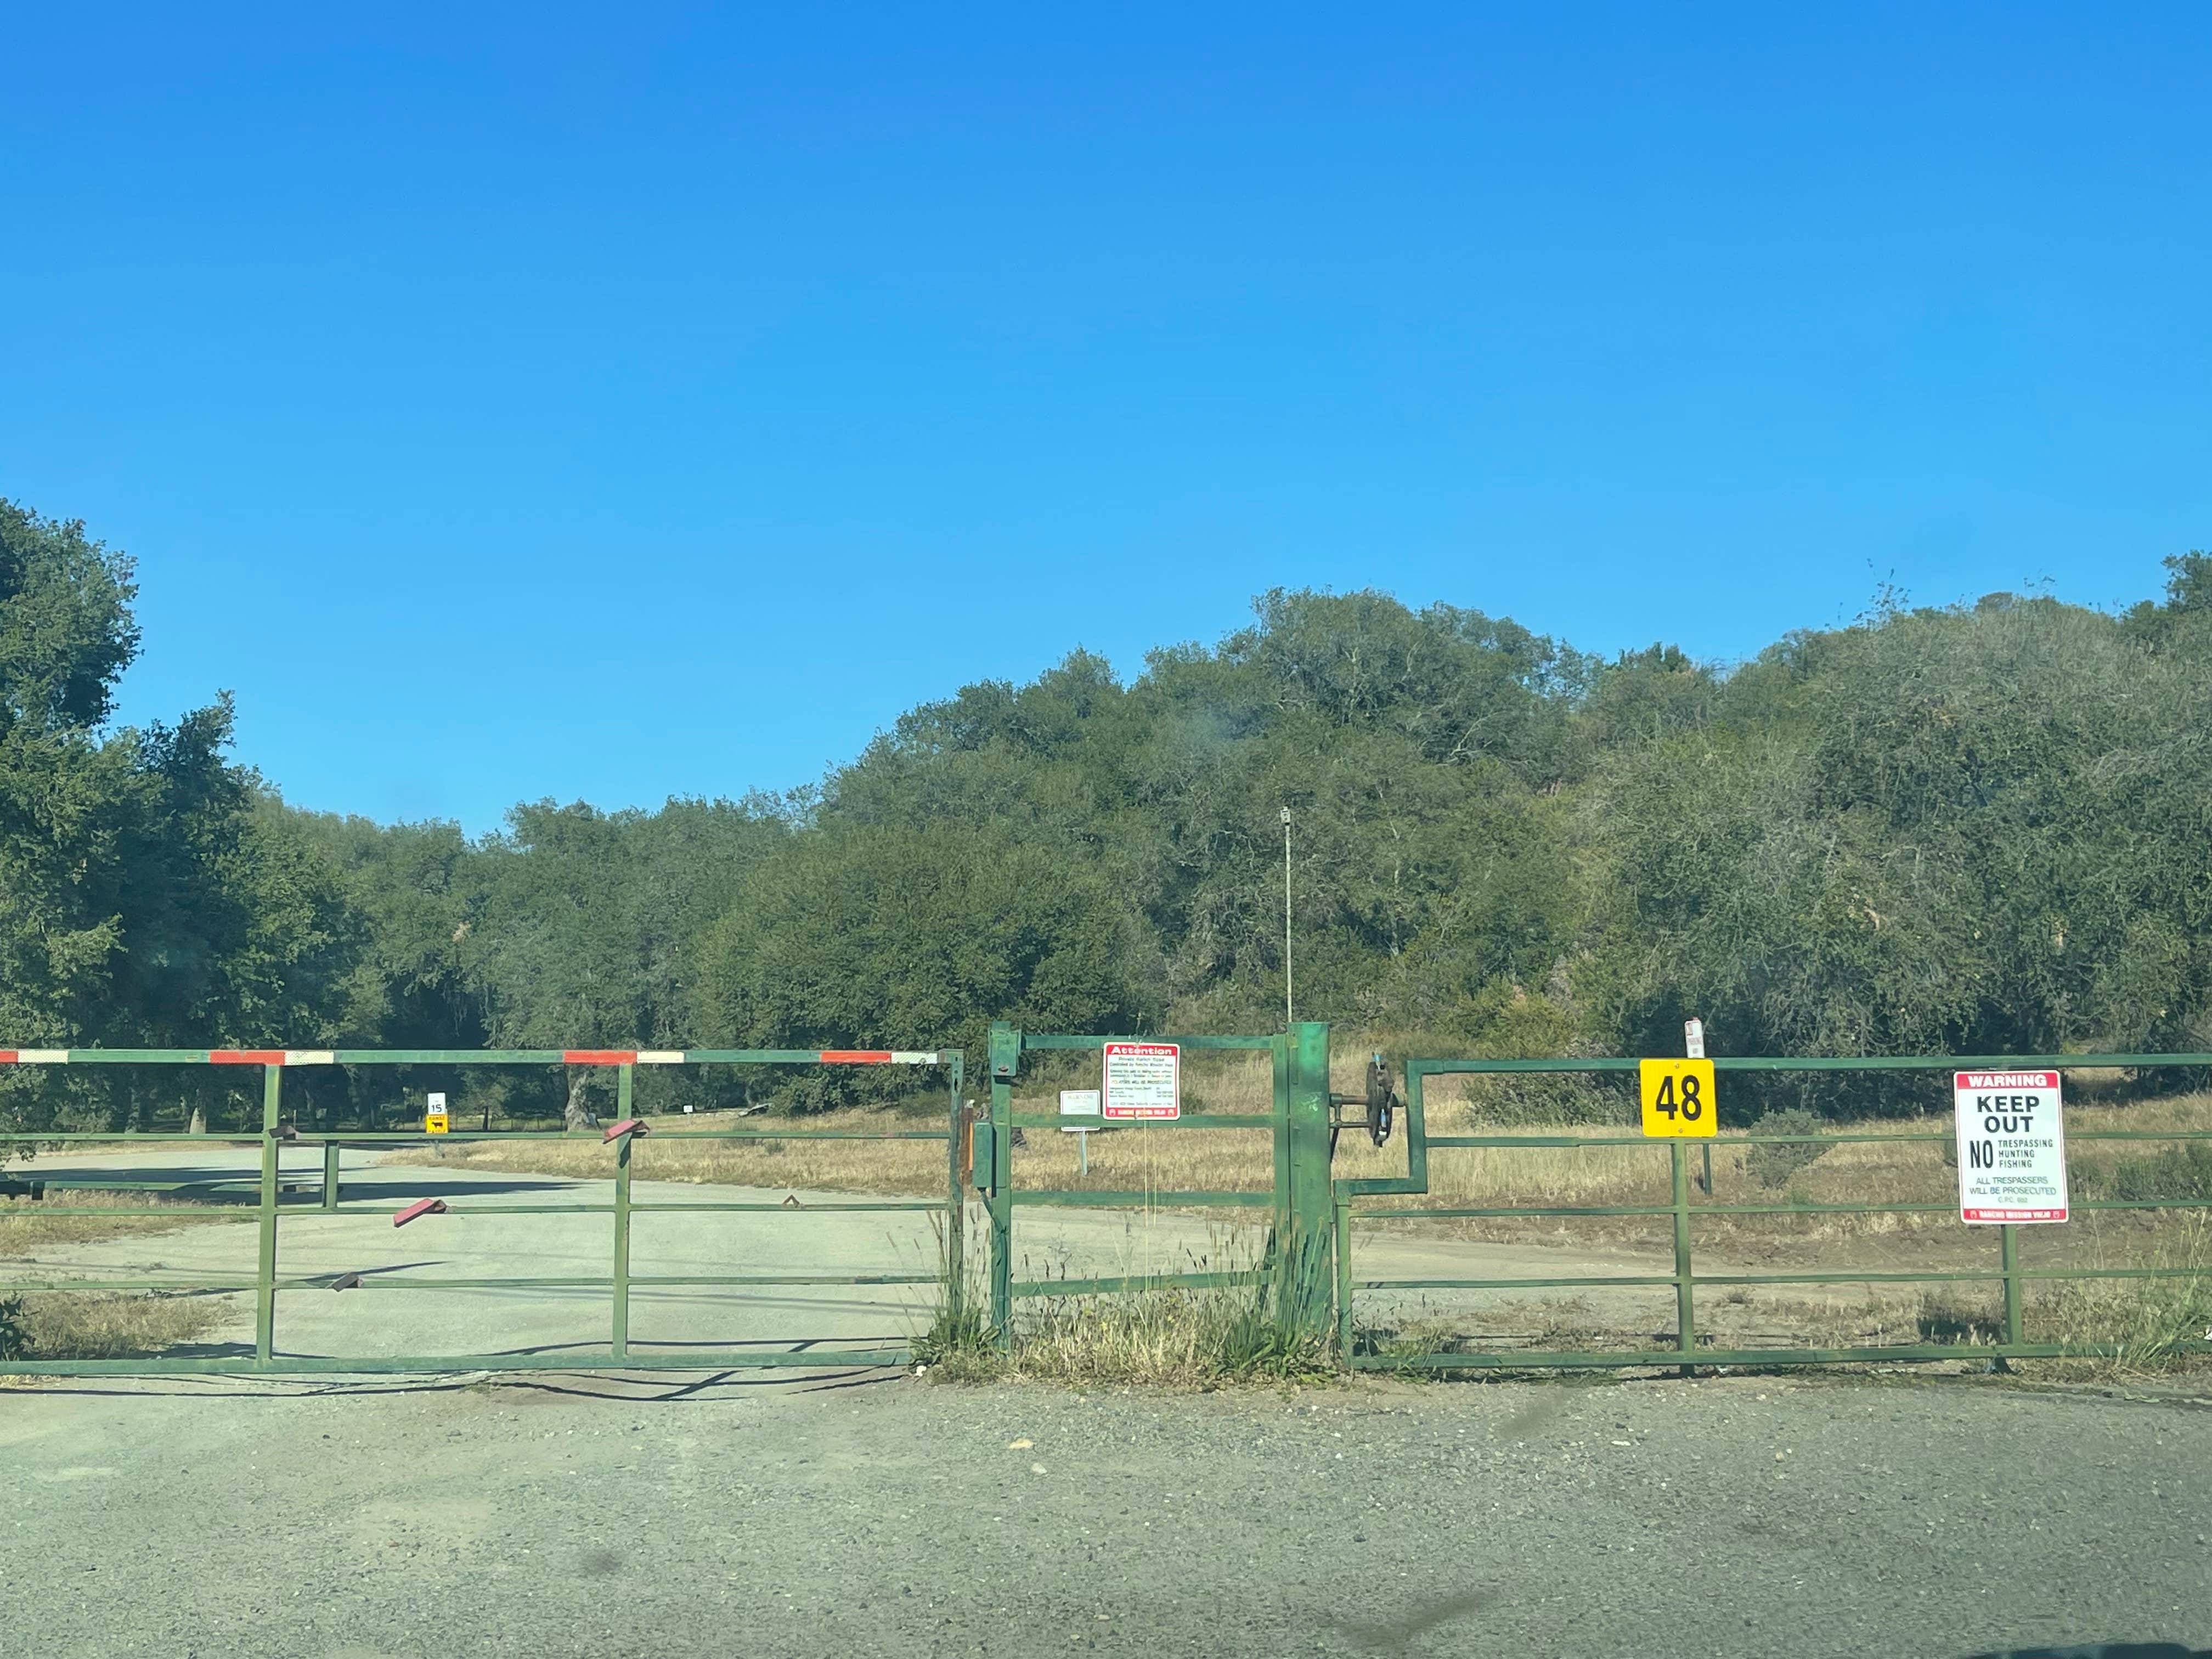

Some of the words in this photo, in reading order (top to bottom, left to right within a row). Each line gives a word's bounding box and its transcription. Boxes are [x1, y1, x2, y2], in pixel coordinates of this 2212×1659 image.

[1110, 1046, 1172, 1055] Attention
[1967, 1074, 2047, 1087] WARNING
[1656, 1074, 1702, 1121] 48
[431, 1104, 442, 1113] 15
[1977, 1096, 2040, 1113] KEEP
[1984, 1115, 2033, 1133] OUT
[1998, 1139, 2053, 1148] TRESPASSING
[1970, 1139, 1994, 1169] NO
[1999, 1149, 2035, 1158] HUNTING
[1999, 1160, 2033, 1168] FISHING
[1993, 1176, 2049, 1184] TRESPASSERS
[2003, 1187, 2057, 1195] PROSECUTED
